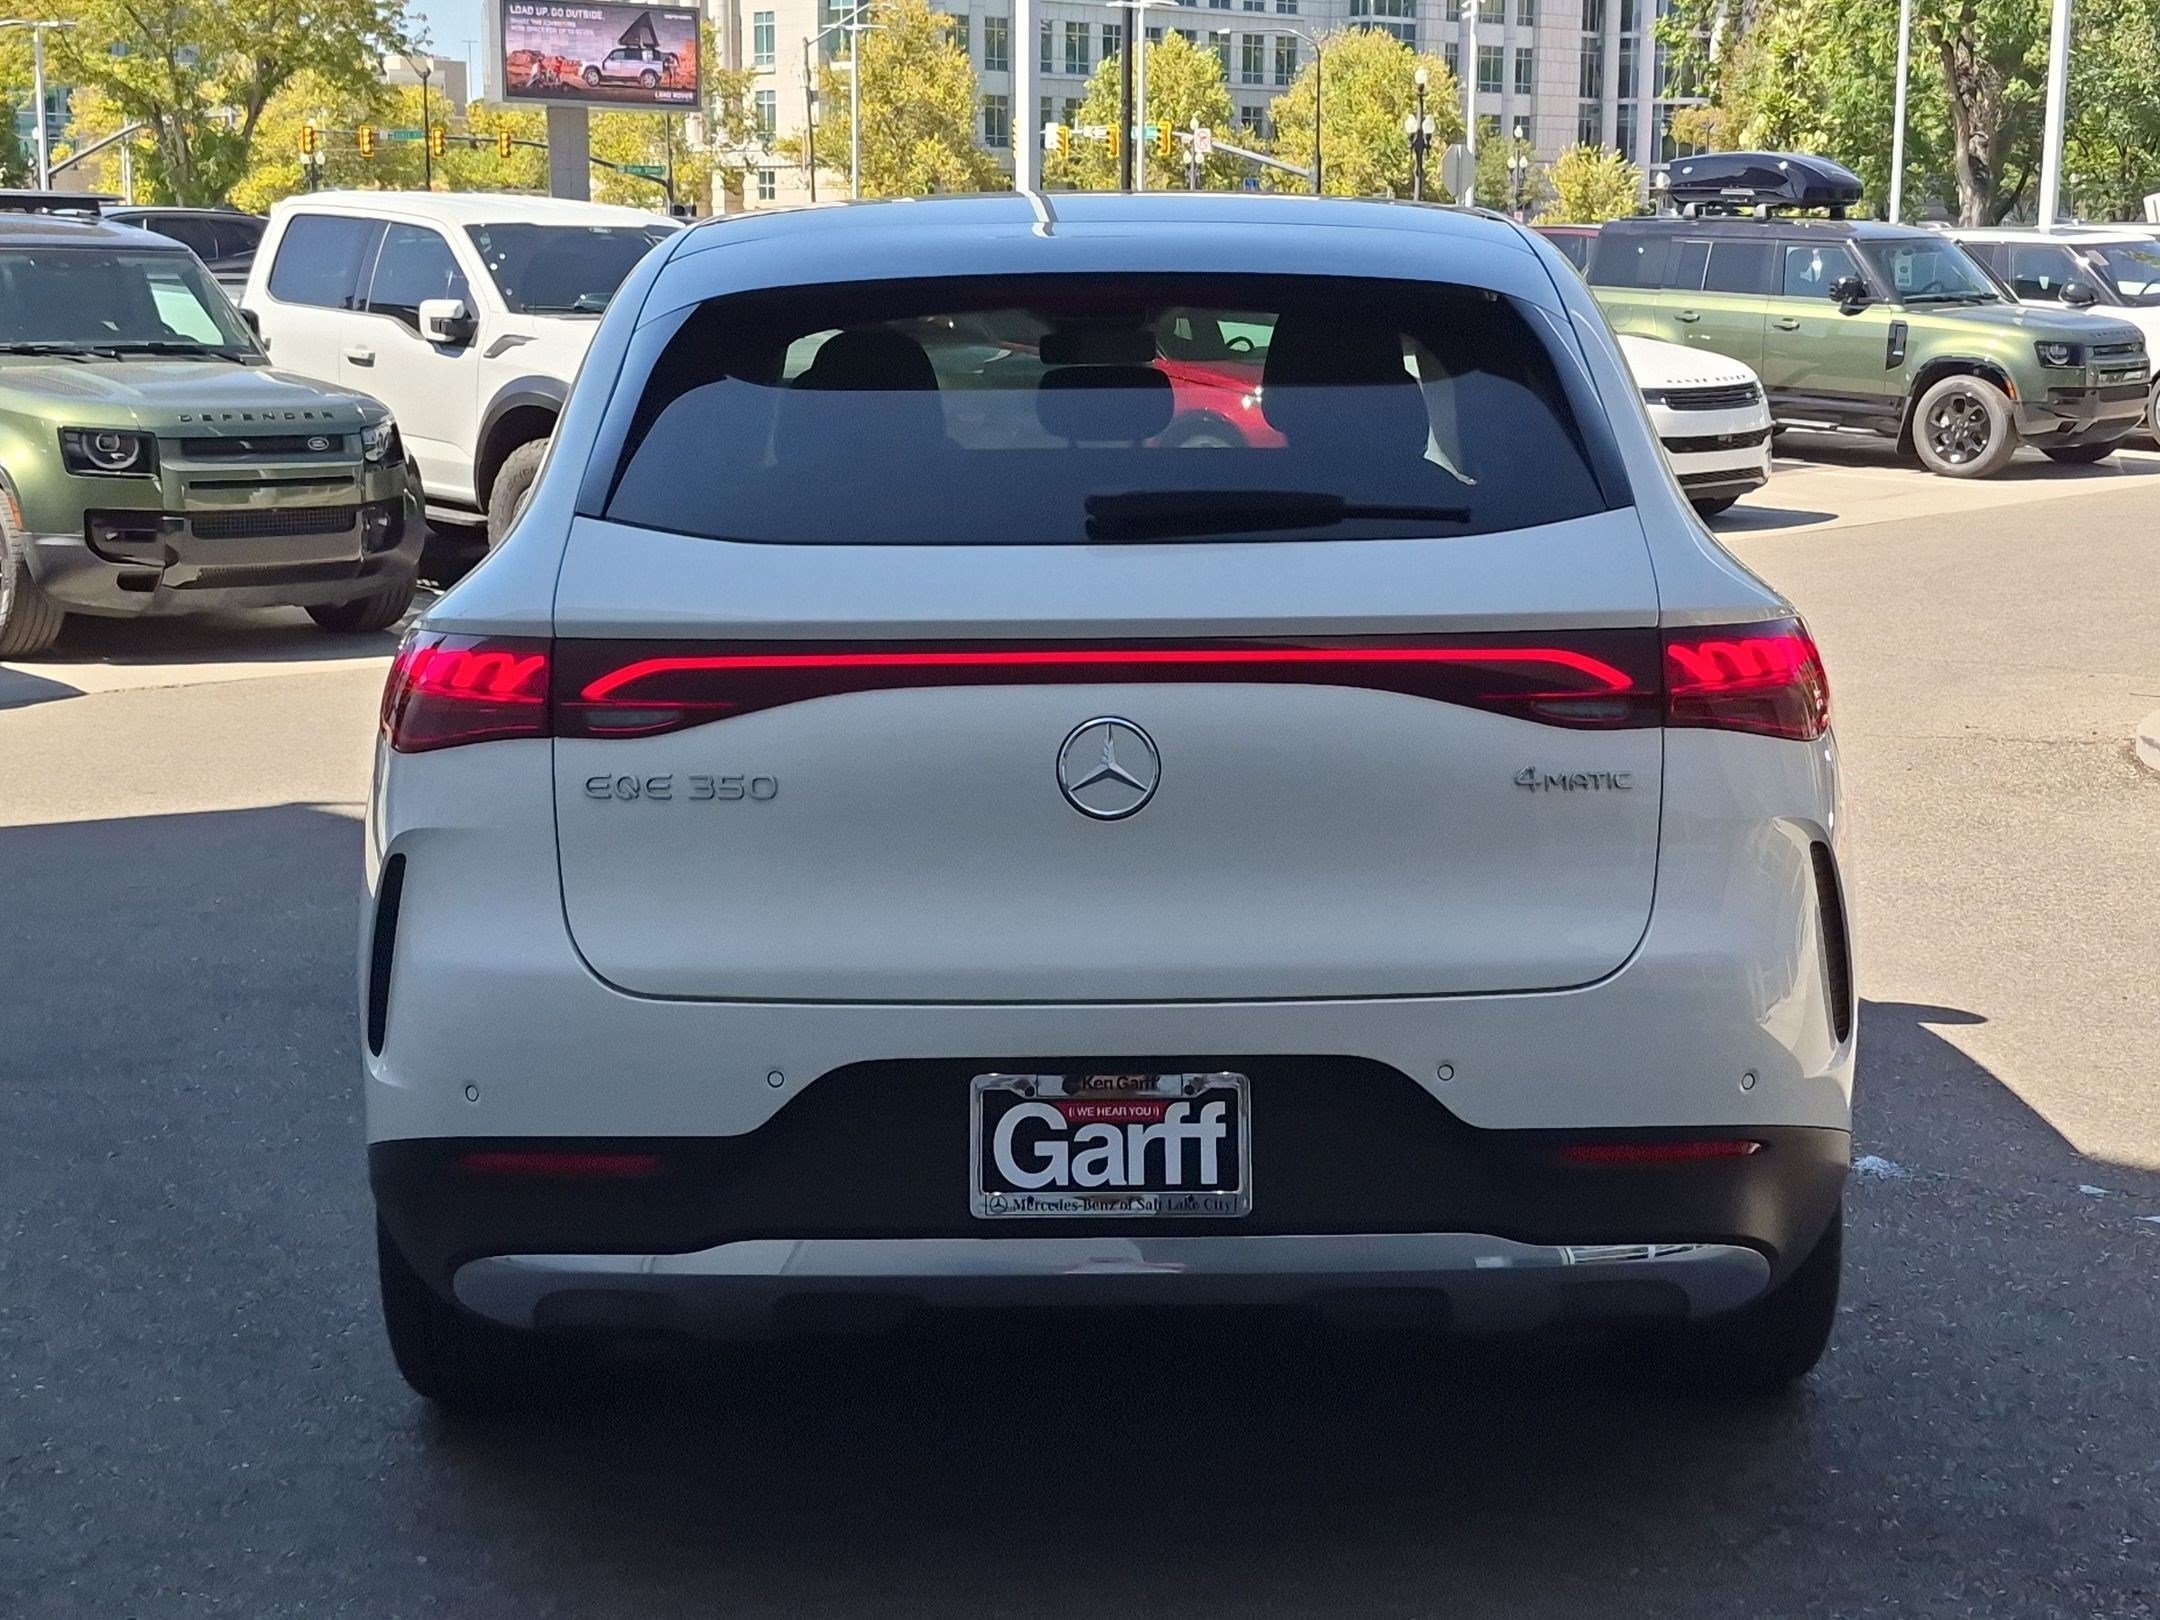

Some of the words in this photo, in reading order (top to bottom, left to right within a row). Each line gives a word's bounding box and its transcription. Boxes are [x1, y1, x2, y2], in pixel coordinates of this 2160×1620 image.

[509, 5, 534, 15] LOAD
[178, 411, 334, 422] DEFENDER
[584, 773, 673, 801] EQE
[687, 773, 779, 801] 350
[1514, 766, 1633, 793] 4MATIC
[1083, 1076, 1113, 1090] Ken
[1097, 1106, 1127, 1117] HEAR
[993, 1101, 1227, 1189] Garff
[1013, 1197, 1115, 1213] Mercedes-Benz
[1119, 1197, 1134, 1212] of
[1138, 1196, 1162, 1212] Salt
[1167, 1196, 1198, 1212] Lake
[1204, 1196, 1232, 1215] City
